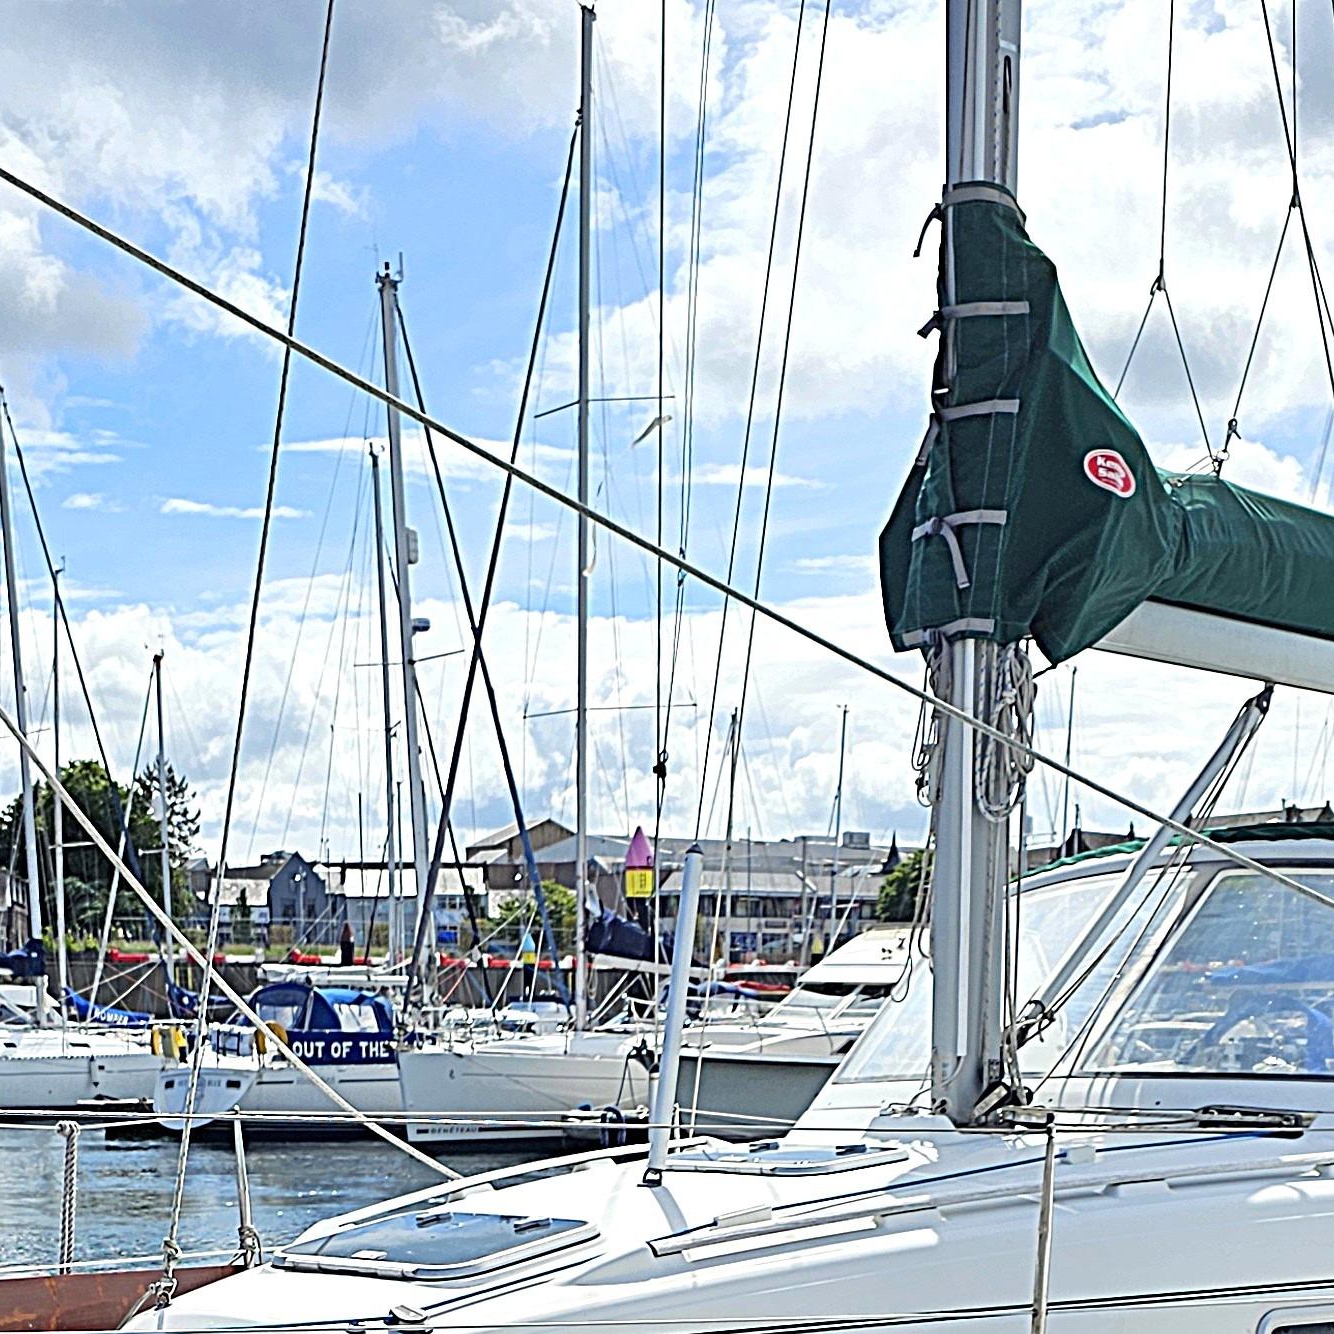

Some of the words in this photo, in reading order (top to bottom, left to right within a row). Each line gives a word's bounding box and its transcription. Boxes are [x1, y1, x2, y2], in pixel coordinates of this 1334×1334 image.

[292, 1040, 326, 1058] OUT
[330, 1041, 353, 1058] OF
[359, 1040, 389, 1058] THE
